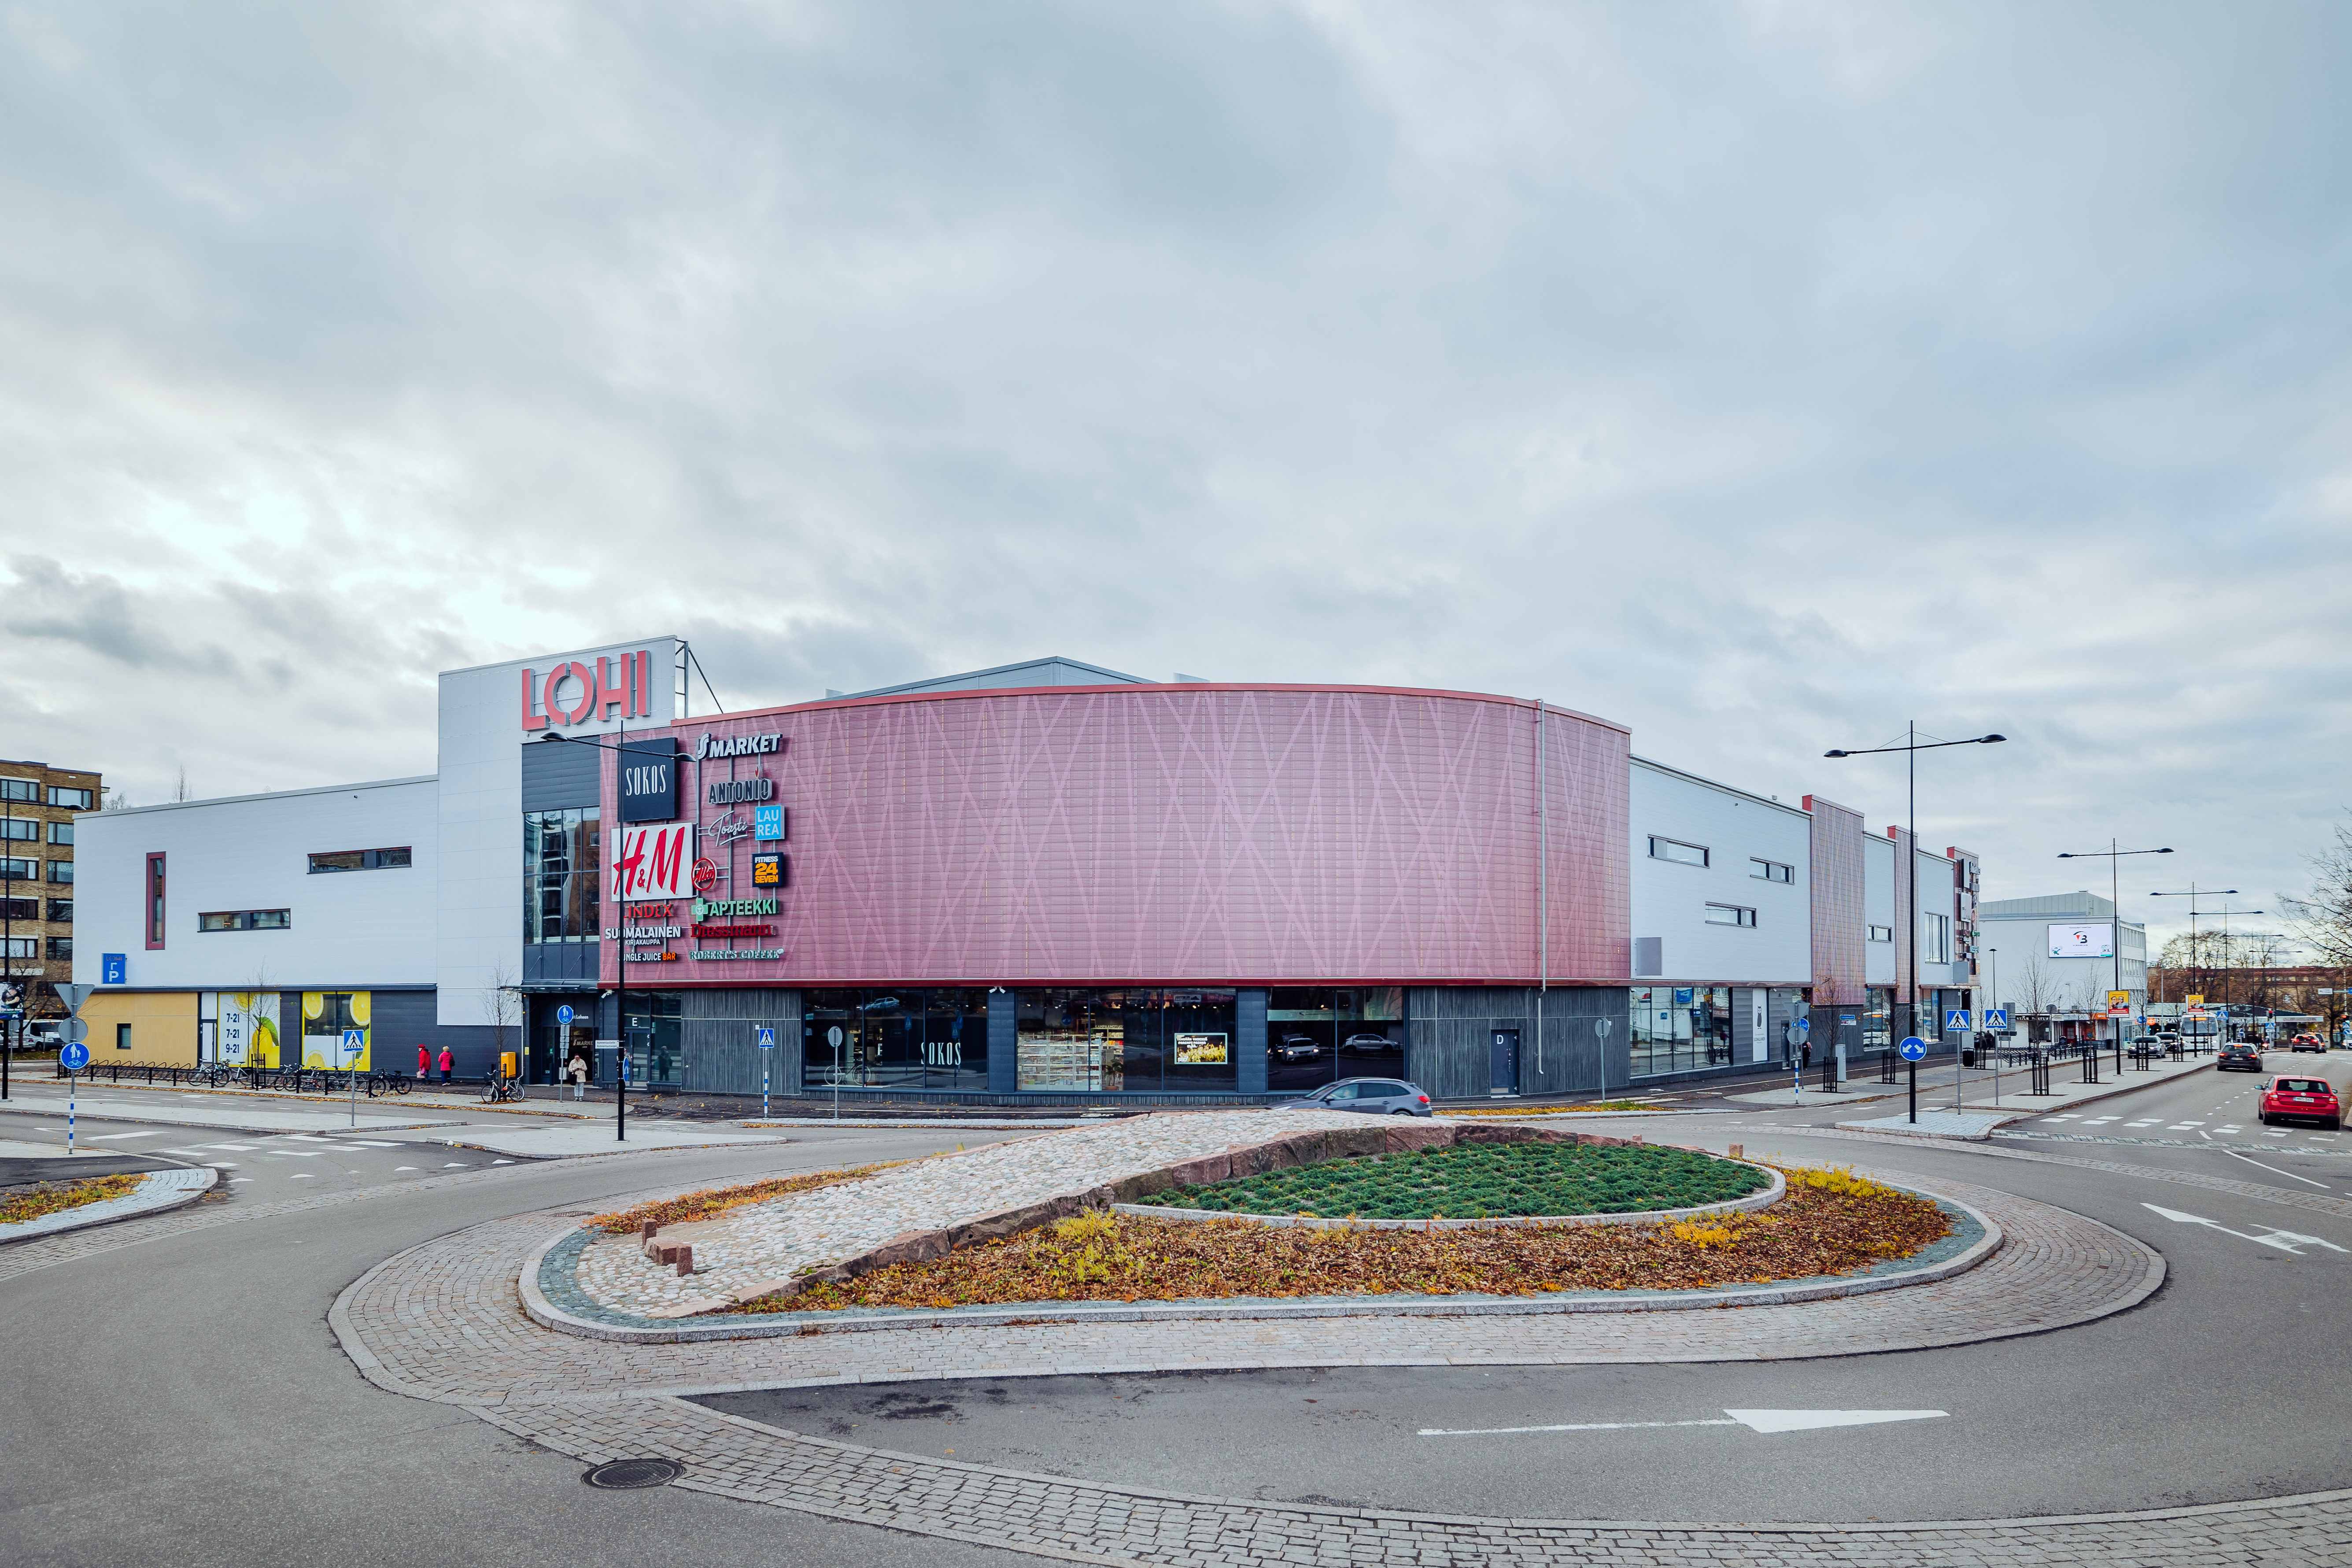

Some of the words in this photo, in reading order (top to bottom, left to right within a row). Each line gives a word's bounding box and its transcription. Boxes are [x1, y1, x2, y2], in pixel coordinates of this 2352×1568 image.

[522, 650, 650, 731] LOHI
[626, 764, 666, 796] SOKOS
[708, 778, 772, 804] ANTONIO
[757, 809, 779, 823] LAU
[708, 810, 748, 847] Toasti
[757, 823, 779, 836] REA
[613, 826, 685, 897] H&M
[693, 865, 714, 882] Alko
[755, 863, 778, 876] 24
[755, 875, 779, 883] SEVEN
[624, 904, 674, 919] INDEX
[709, 899, 776, 916] APTEEKKI
[690, 924, 772, 938] Dressmann
[642, 952, 661, 961] JUICE
[663, 952, 676, 961] BAR
[690, 950, 737, 960] ROBERT'S
[109, 970, 119, 982] P
[226, 1013, 240, 1023] 7-21
[632, 1017, 638, 1026] E
[226, 1029, 240, 1039] 7-21
[1497, 1035, 1504, 1044] D
[225, 1043, 240, 1054] 9-21
[921, 1042, 961, 1066] SOKOS
